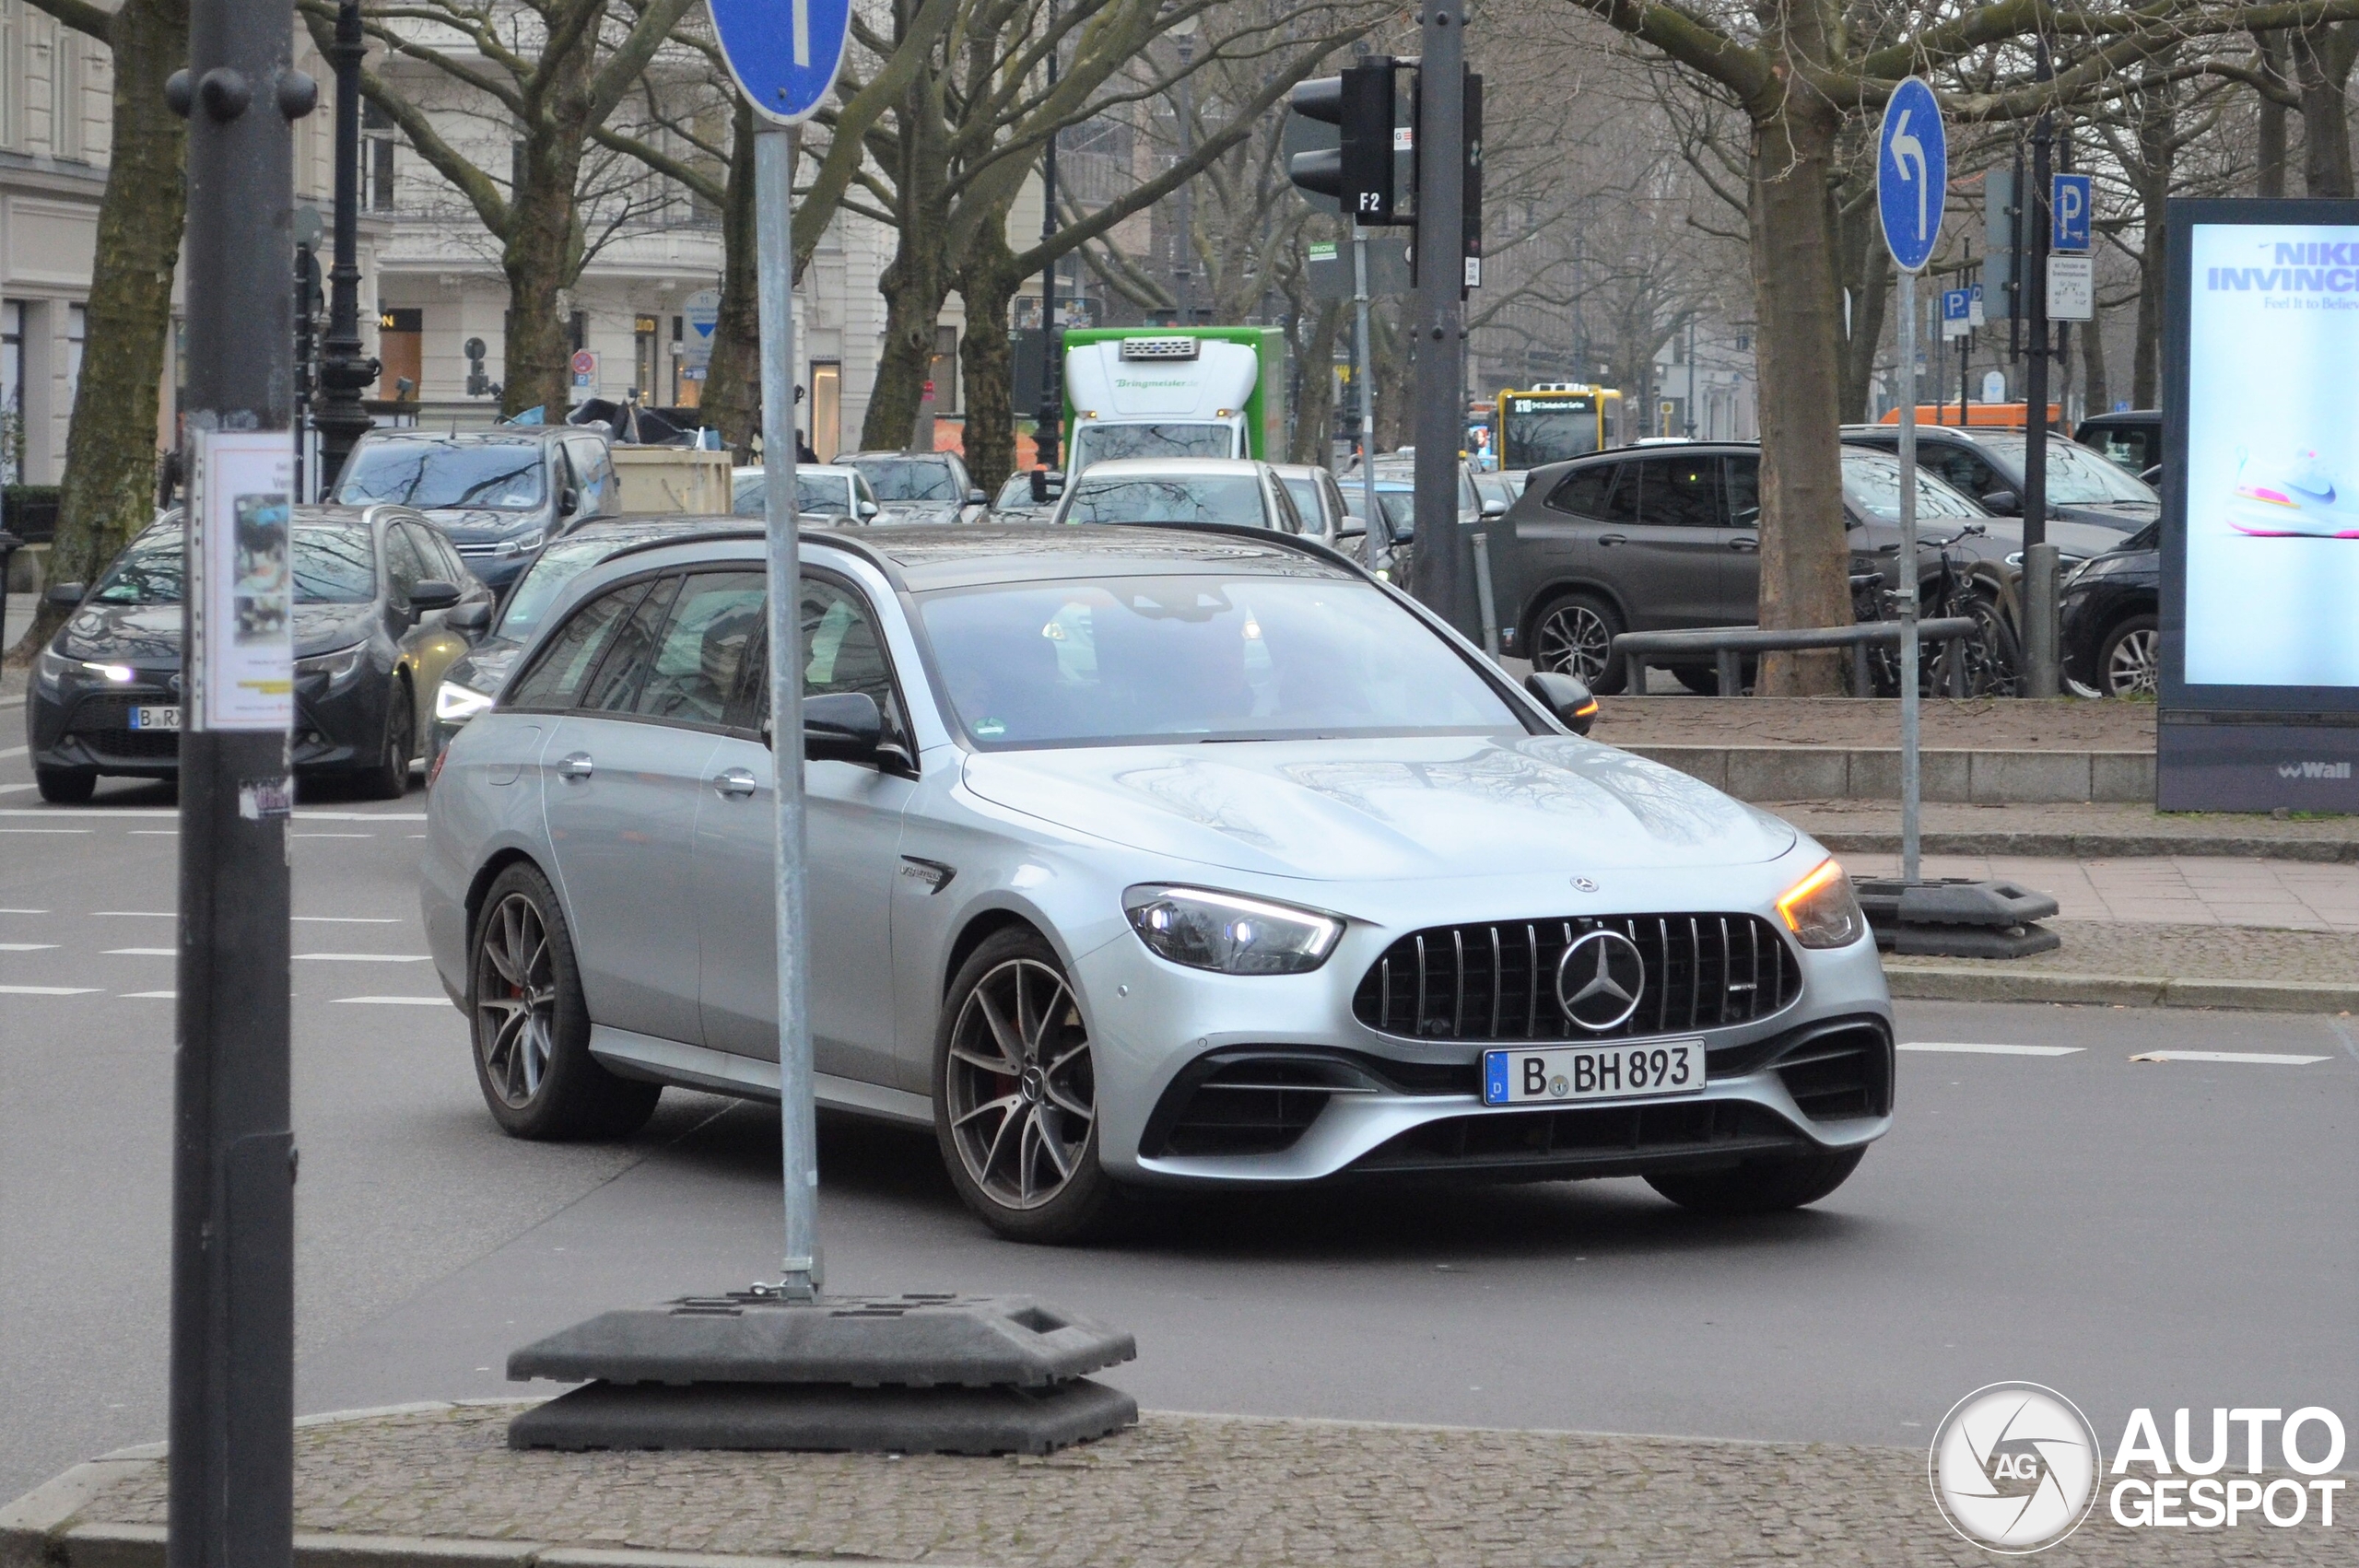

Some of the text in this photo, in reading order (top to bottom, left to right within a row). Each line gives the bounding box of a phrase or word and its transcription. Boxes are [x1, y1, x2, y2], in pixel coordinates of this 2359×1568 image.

[1360, 193, 1379, 210] F2
[2061, 185, 2082, 240] P
[1949, 294, 1964, 316] P
[2264, 297, 2290, 309] Feel
[2294, 297, 2303, 309] It
[2306, 298, 2319, 310] to
[382, 314, 394, 327] N
[1515, 399, 1532, 413] X10
[141, 710, 151, 726] B
[2302, 762, 2351, 778] Wall
[1523, 1047, 1690, 1095] B BH 893
[1493, 1082, 1502, 1094] D
